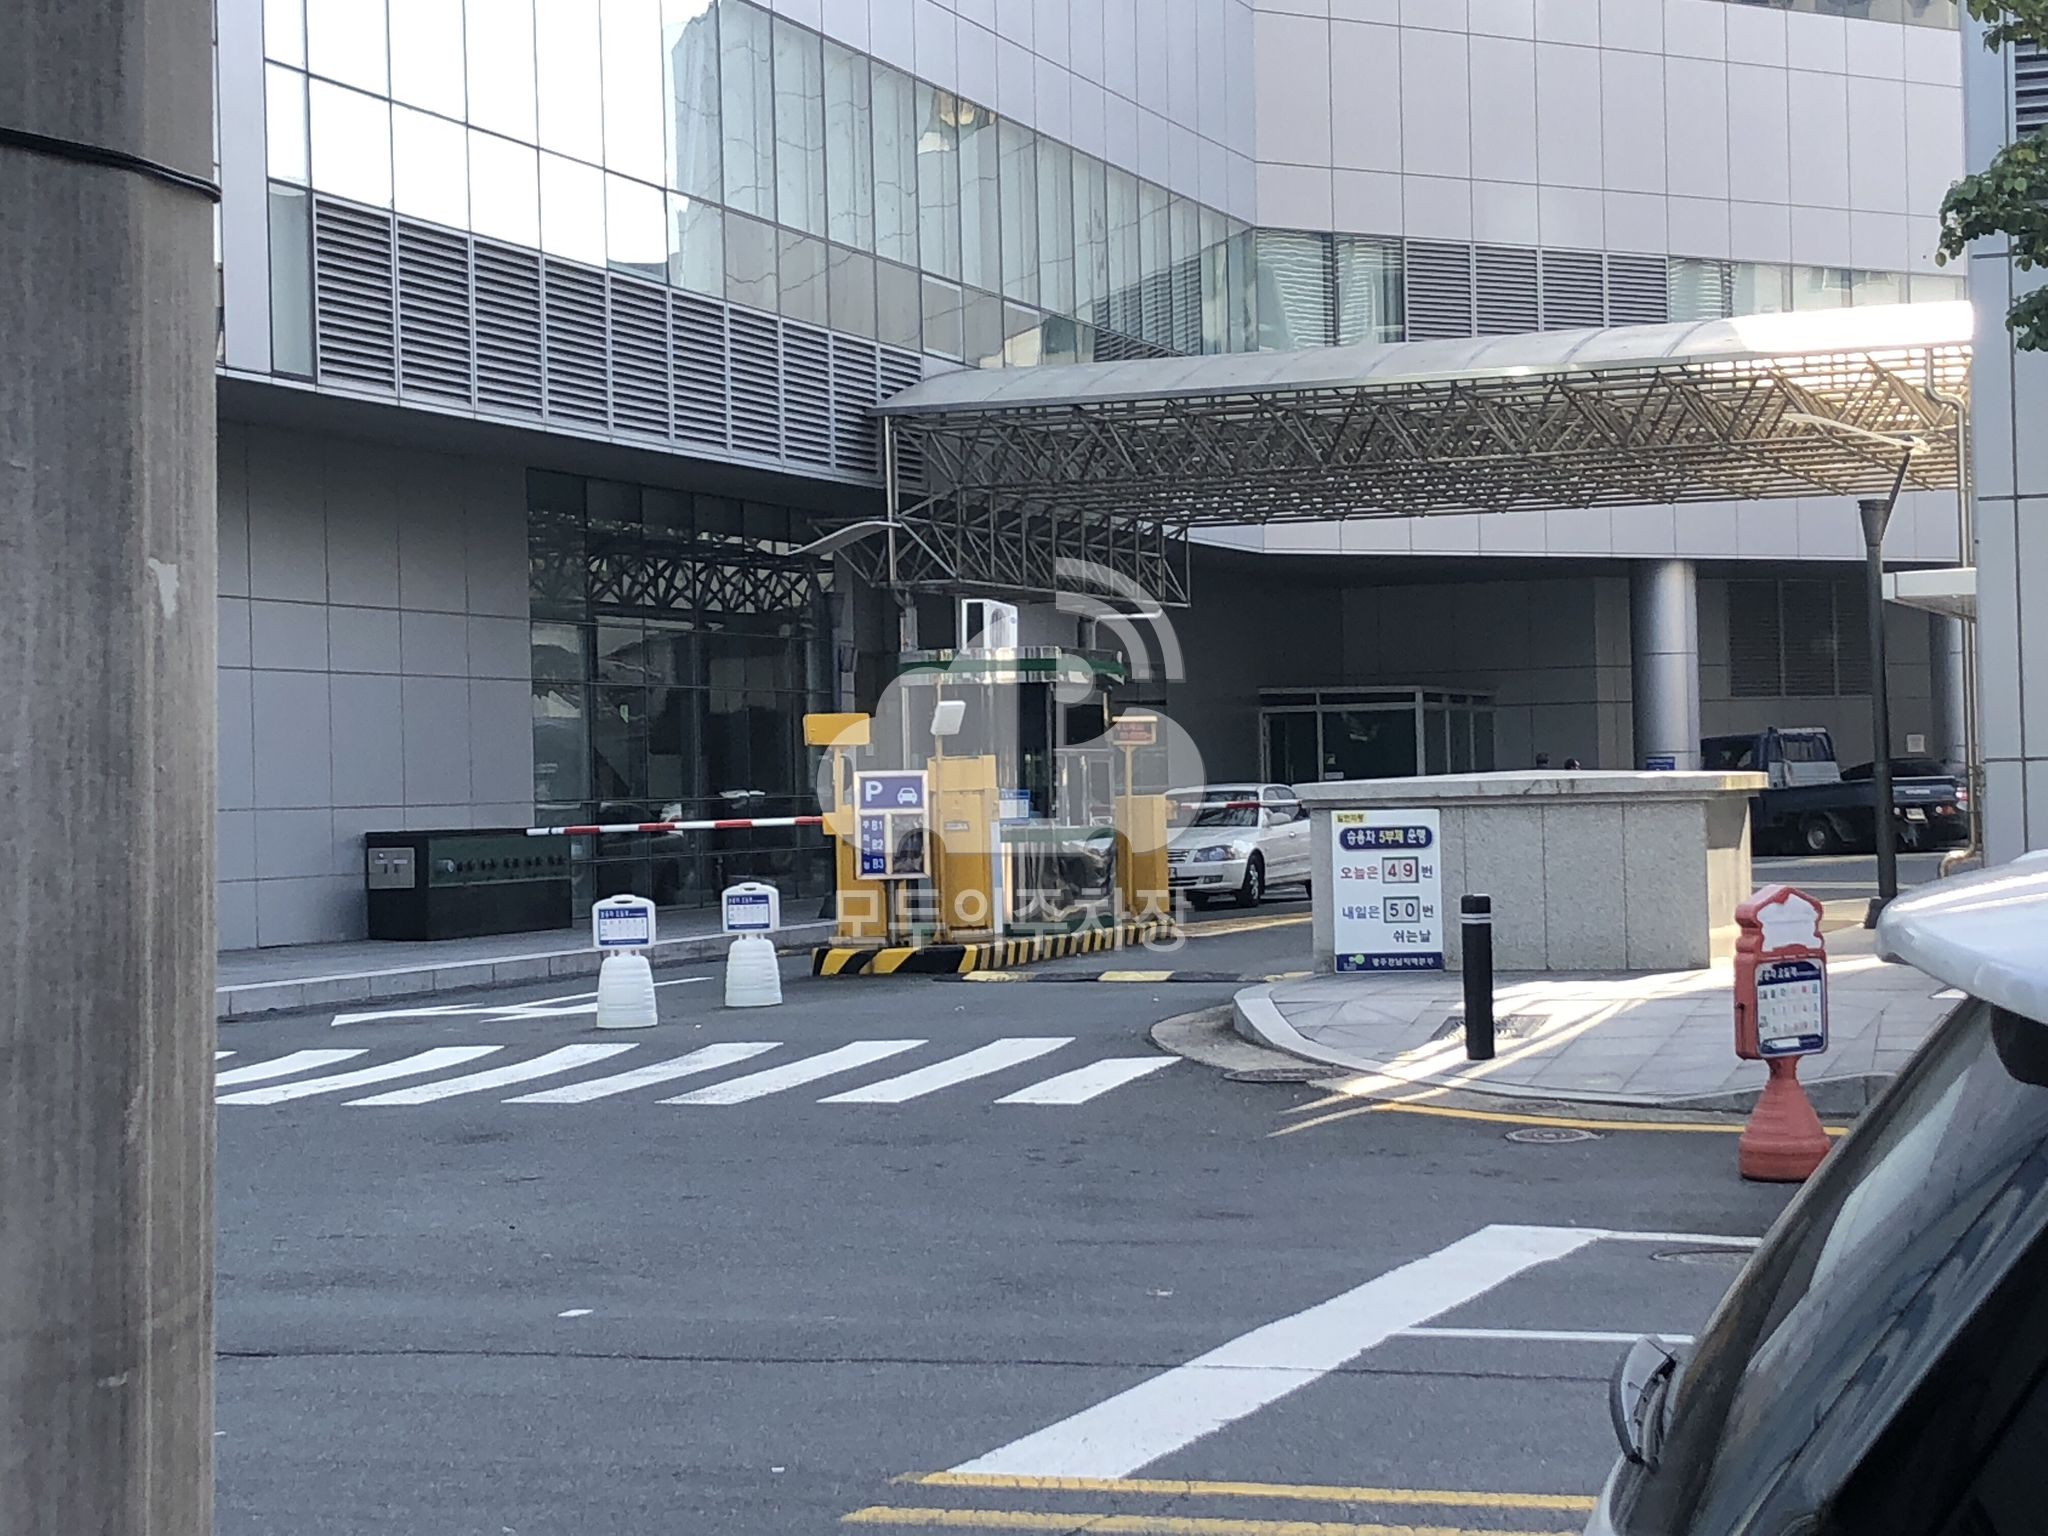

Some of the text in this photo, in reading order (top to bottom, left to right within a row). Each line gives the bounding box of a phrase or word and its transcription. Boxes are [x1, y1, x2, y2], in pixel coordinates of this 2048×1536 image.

[864, 780, 884, 802] P
[871, 819, 883, 831] B1
[871, 838, 884, 850] B2
[872, 858, 884, 869] B3
[1340, 865, 1379, 880] 오늘은
[1421, 865, 1434, 879] 번
[1342, 905, 1381, 920] 내일은
[1422, 904, 1435, 919] 번
[1392, 929, 1432, 943] 쉬는날
